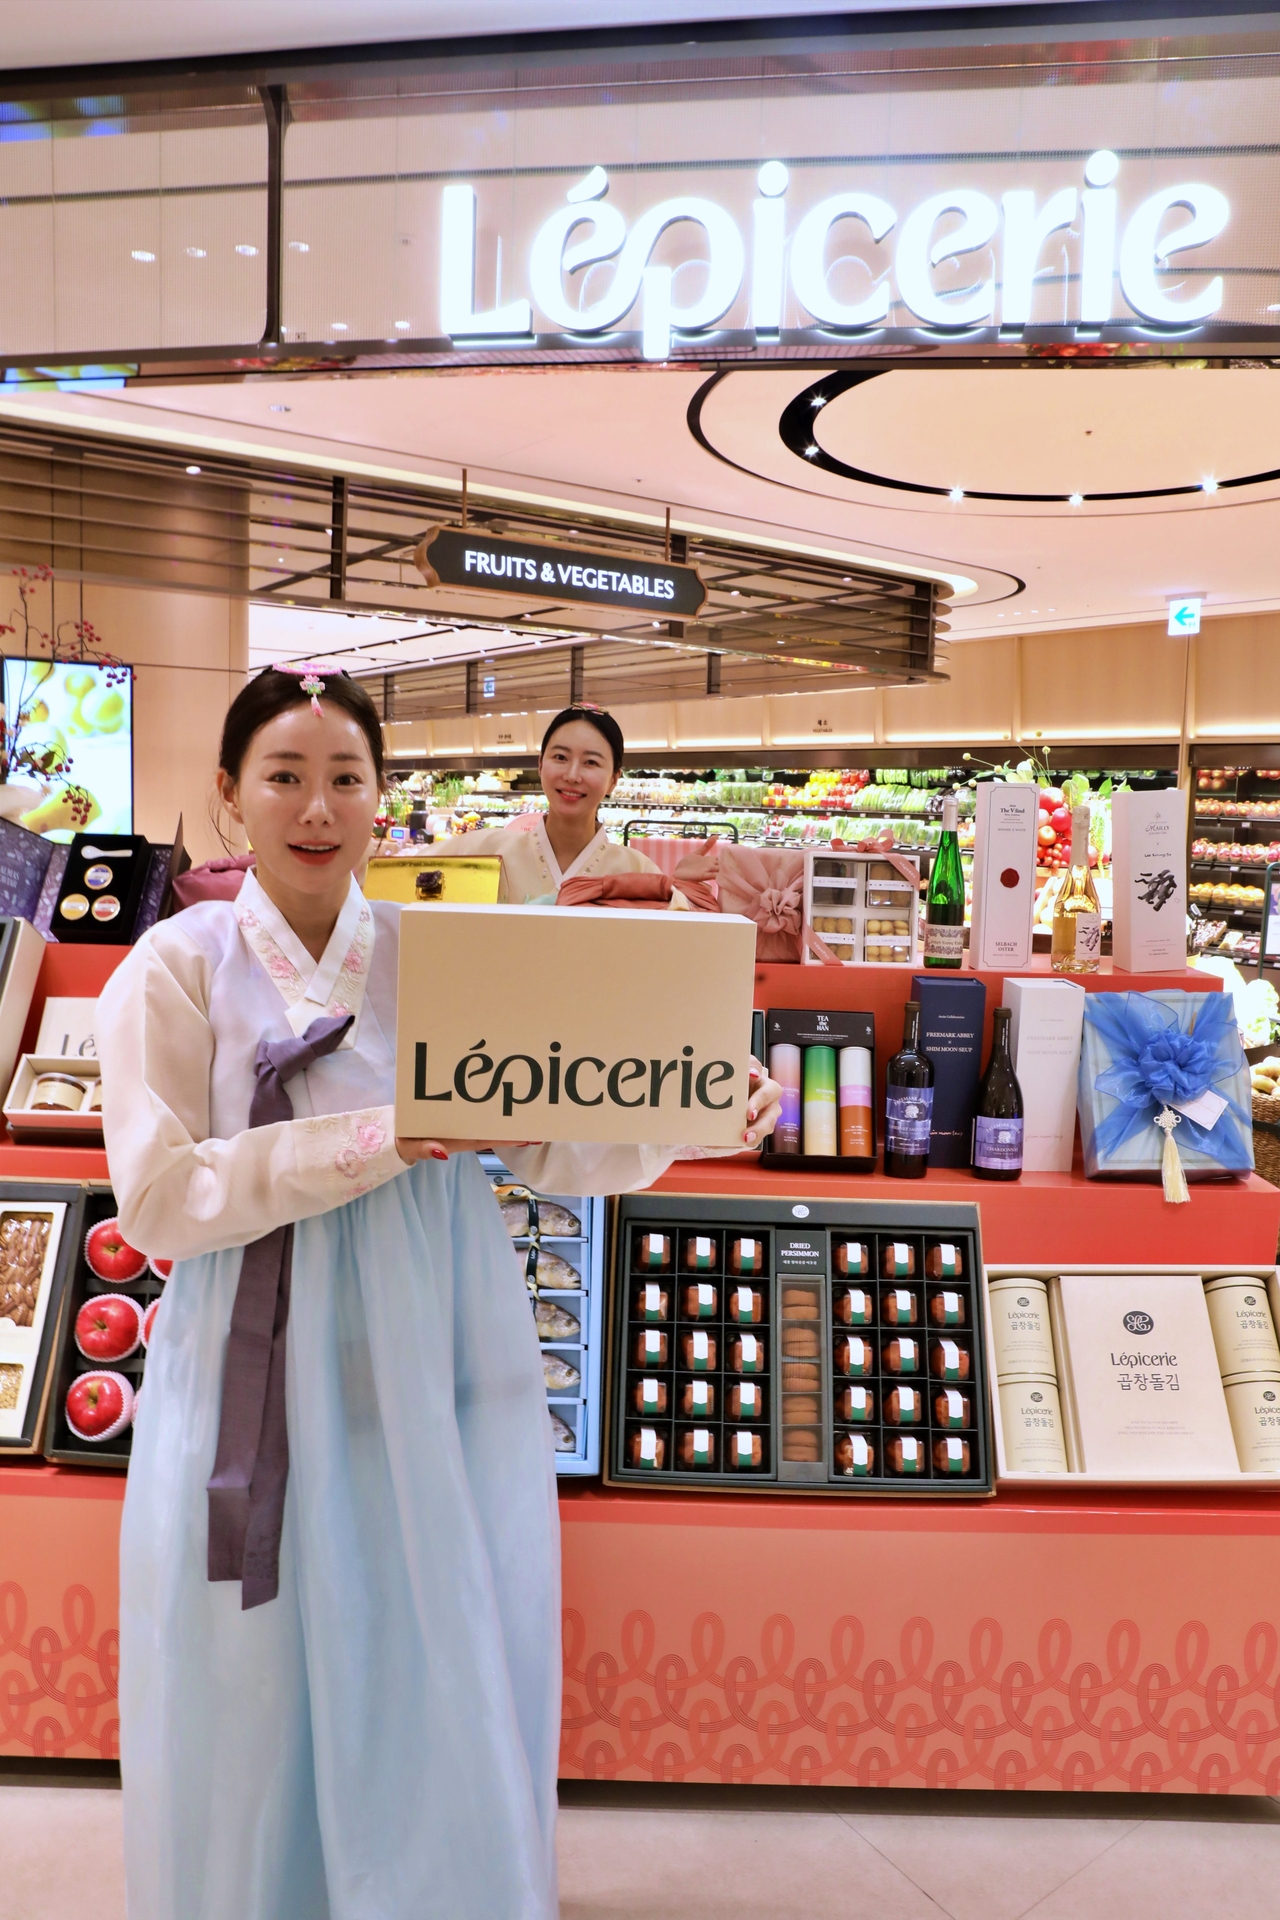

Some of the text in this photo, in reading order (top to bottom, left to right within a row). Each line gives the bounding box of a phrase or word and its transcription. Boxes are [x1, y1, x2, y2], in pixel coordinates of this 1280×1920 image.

[441, 150, 1230, 359] Lépicerie
[464, 549, 675, 600] FRUITS & VEGETABLES
[414, 1038, 735, 1117] Lépicerie
[780, 1249, 820, 1258] PERSIMMON
[1007, 1310, 1041, 1320] Lépicerie
[1235, 1309, 1267, 1319] Lépicerie
[1010, 1321, 1041, 1331] 곱창돌김
[1239, 1319, 1269, 1330] 곱창돌김
[1110, 1351, 1178, 1369] Lépicerie
[1117, 1373, 1180, 1391] 곱창돌김
[1020, 1406, 1054, 1416] Lépicerie
[1023, 1417, 1054, 1428] 곱창돌김
